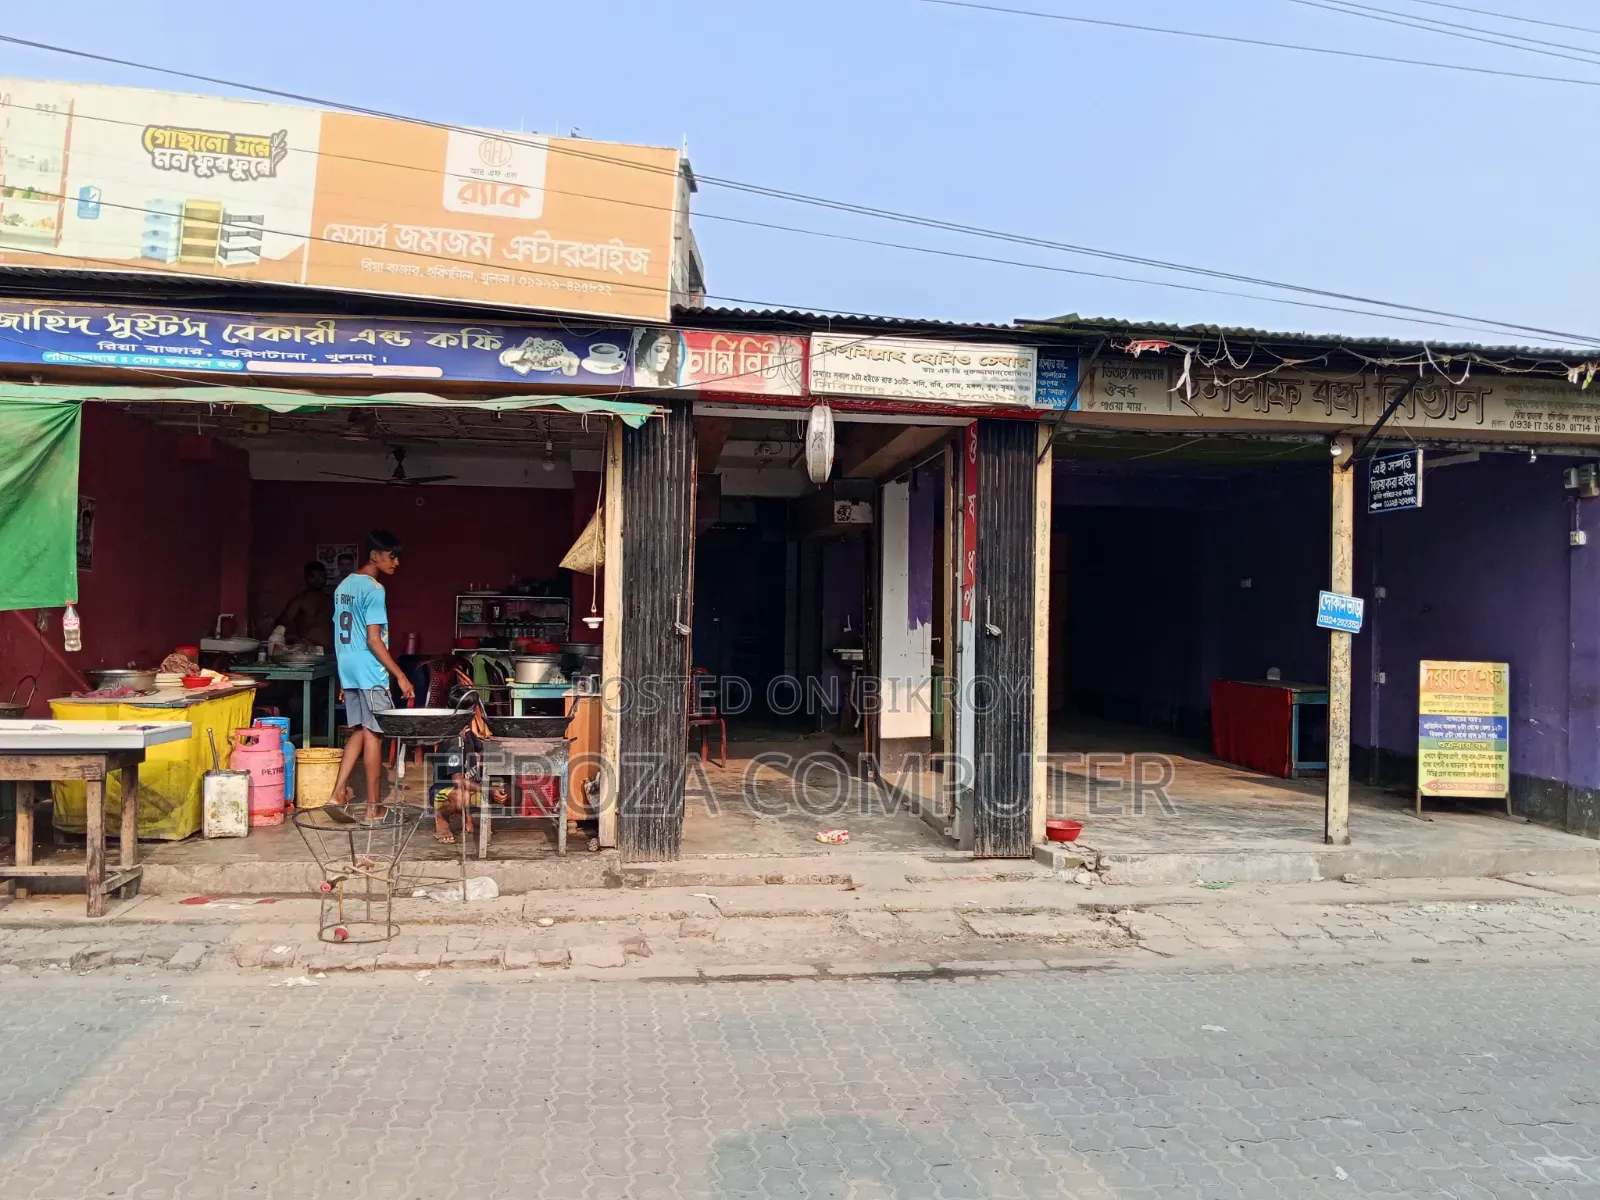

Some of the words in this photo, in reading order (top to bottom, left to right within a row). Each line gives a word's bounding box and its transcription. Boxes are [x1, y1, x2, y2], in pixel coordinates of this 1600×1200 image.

[144, 127, 231, 155] গোছানো
[152, 149, 190, 171] মন
[192, 151, 273, 180] ফুরফুরে
[323, 223, 388, 249] মেসার্স
[393, 223, 495, 261] জমজম
[501, 230, 652, 276] এন্টারপ্রাইজ
[97, 341, 137, 353] রিয়া
[222, 319, 338, 346] বেকারী
[349, 327, 413, 348] এন্ড
[423, 327, 504, 351] কফি
[911, 350, 972, 366] হোমিও
[1104, 381, 1138, 398] ঔষধ
[1372, 460, 1387, 475] এই
[1385, 476, 1398, 490] করা
[1397, 470, 1417, 487] হইবে
[340, 610, 353, 645] 9
